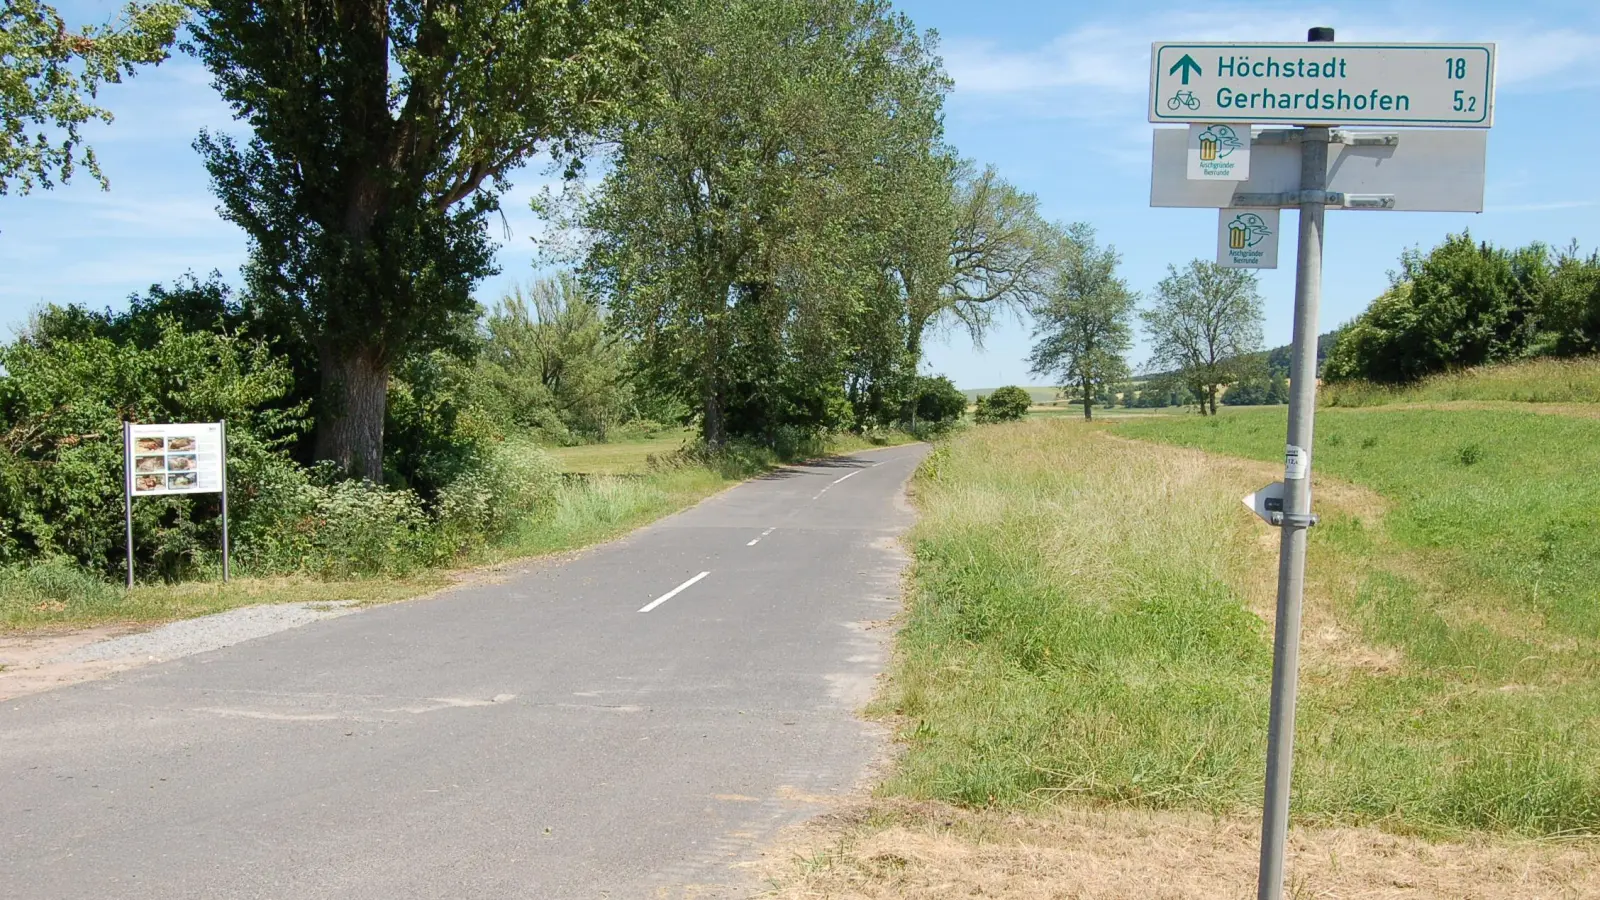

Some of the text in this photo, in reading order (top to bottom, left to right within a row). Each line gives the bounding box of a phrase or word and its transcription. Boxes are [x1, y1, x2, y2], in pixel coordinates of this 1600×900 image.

[1218, 56, 1466, 79] Höchstadt 18
[1216, 87, 1410, 111] Gerhardshofen
